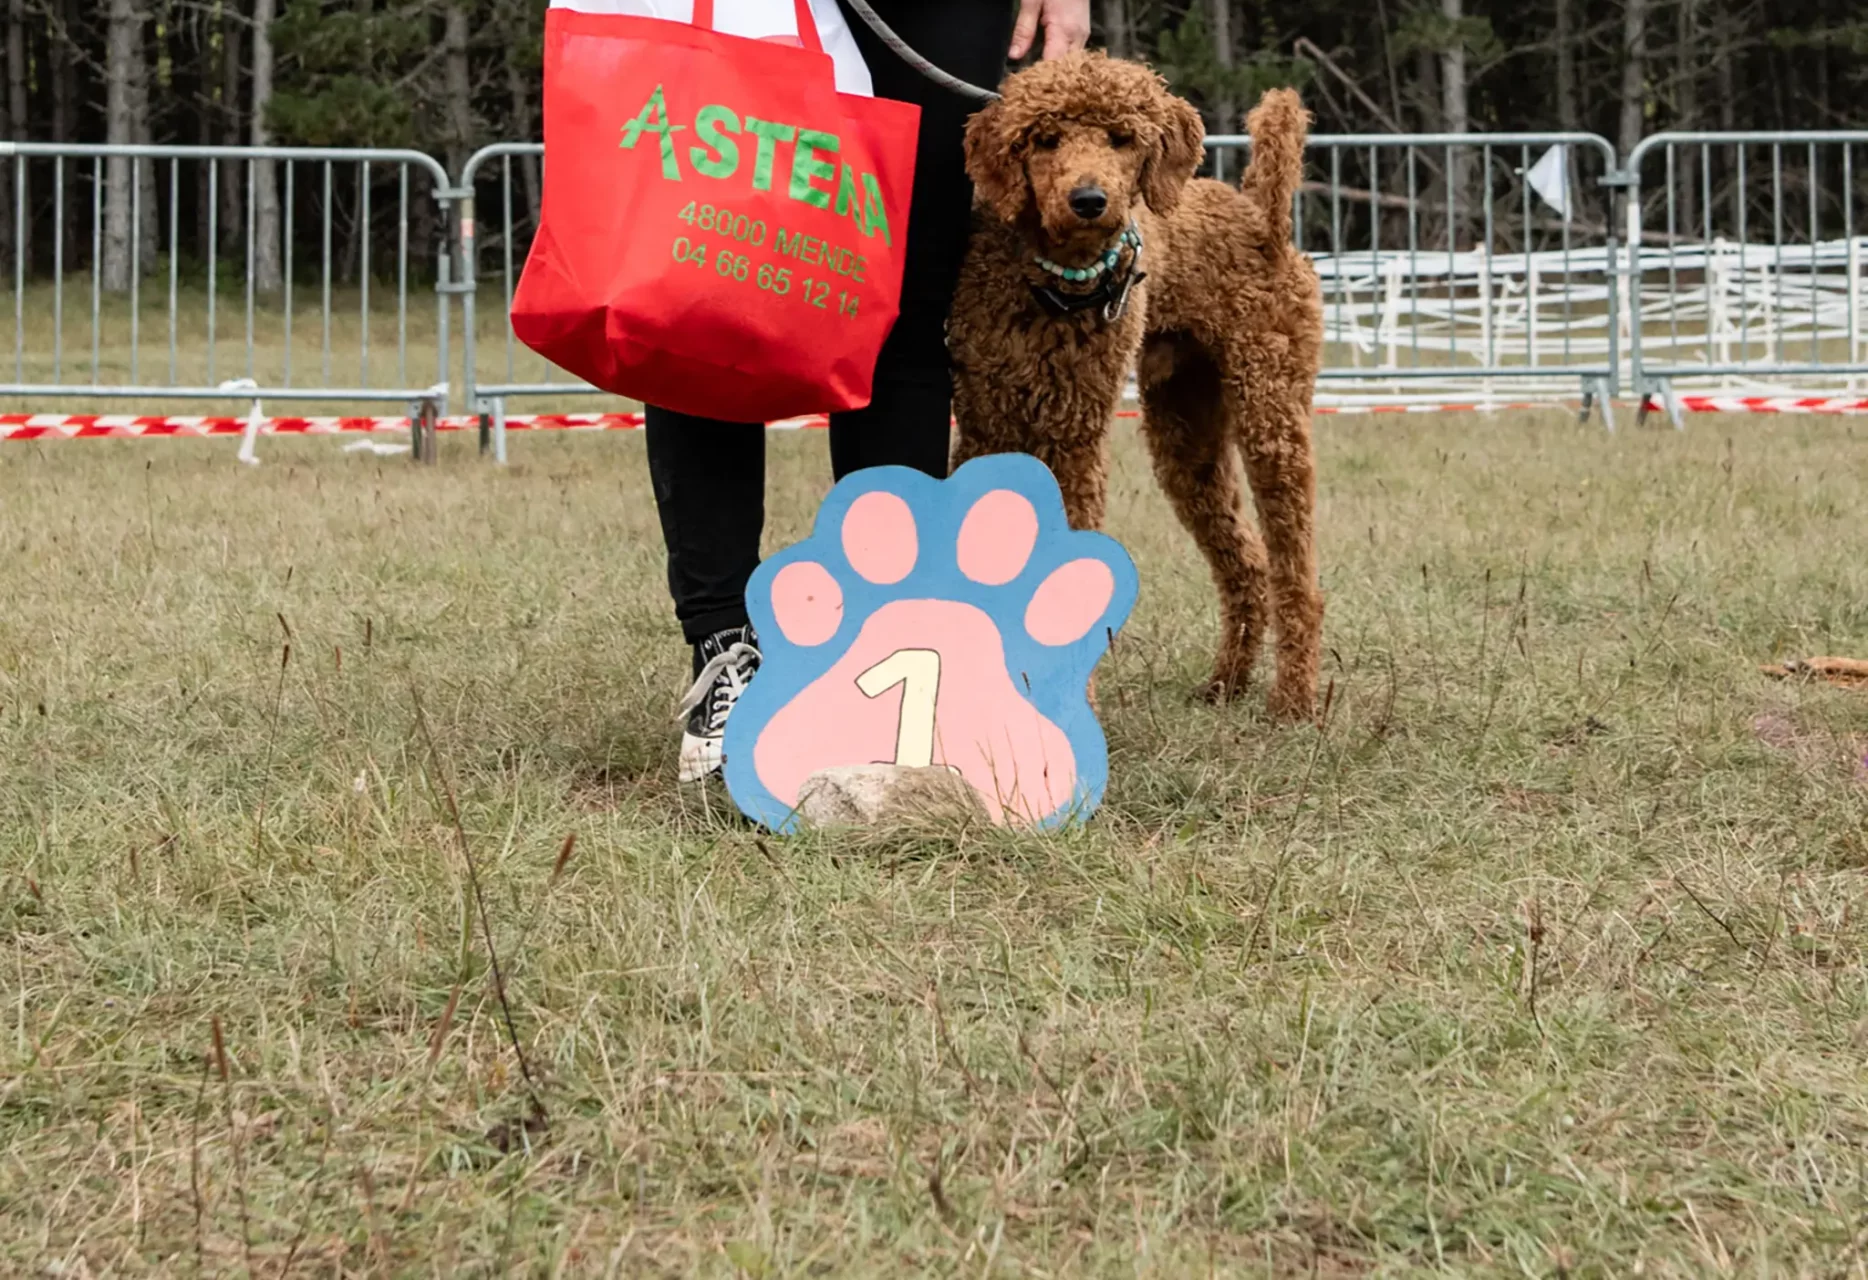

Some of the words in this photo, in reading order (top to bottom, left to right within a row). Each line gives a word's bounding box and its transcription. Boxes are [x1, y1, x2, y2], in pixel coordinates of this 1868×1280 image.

[672, 236, 707, 269] 04
[715, 249, 751, 282] 66
[756, 263, 793, 295] 65
[801, 277, 831, 309] 12
[837, 289, 861, 319] 14
[678, 200, 767, 247] 48000
[773, 226, 868, 283] MENDE
[853, 647, 963, 776] 1
